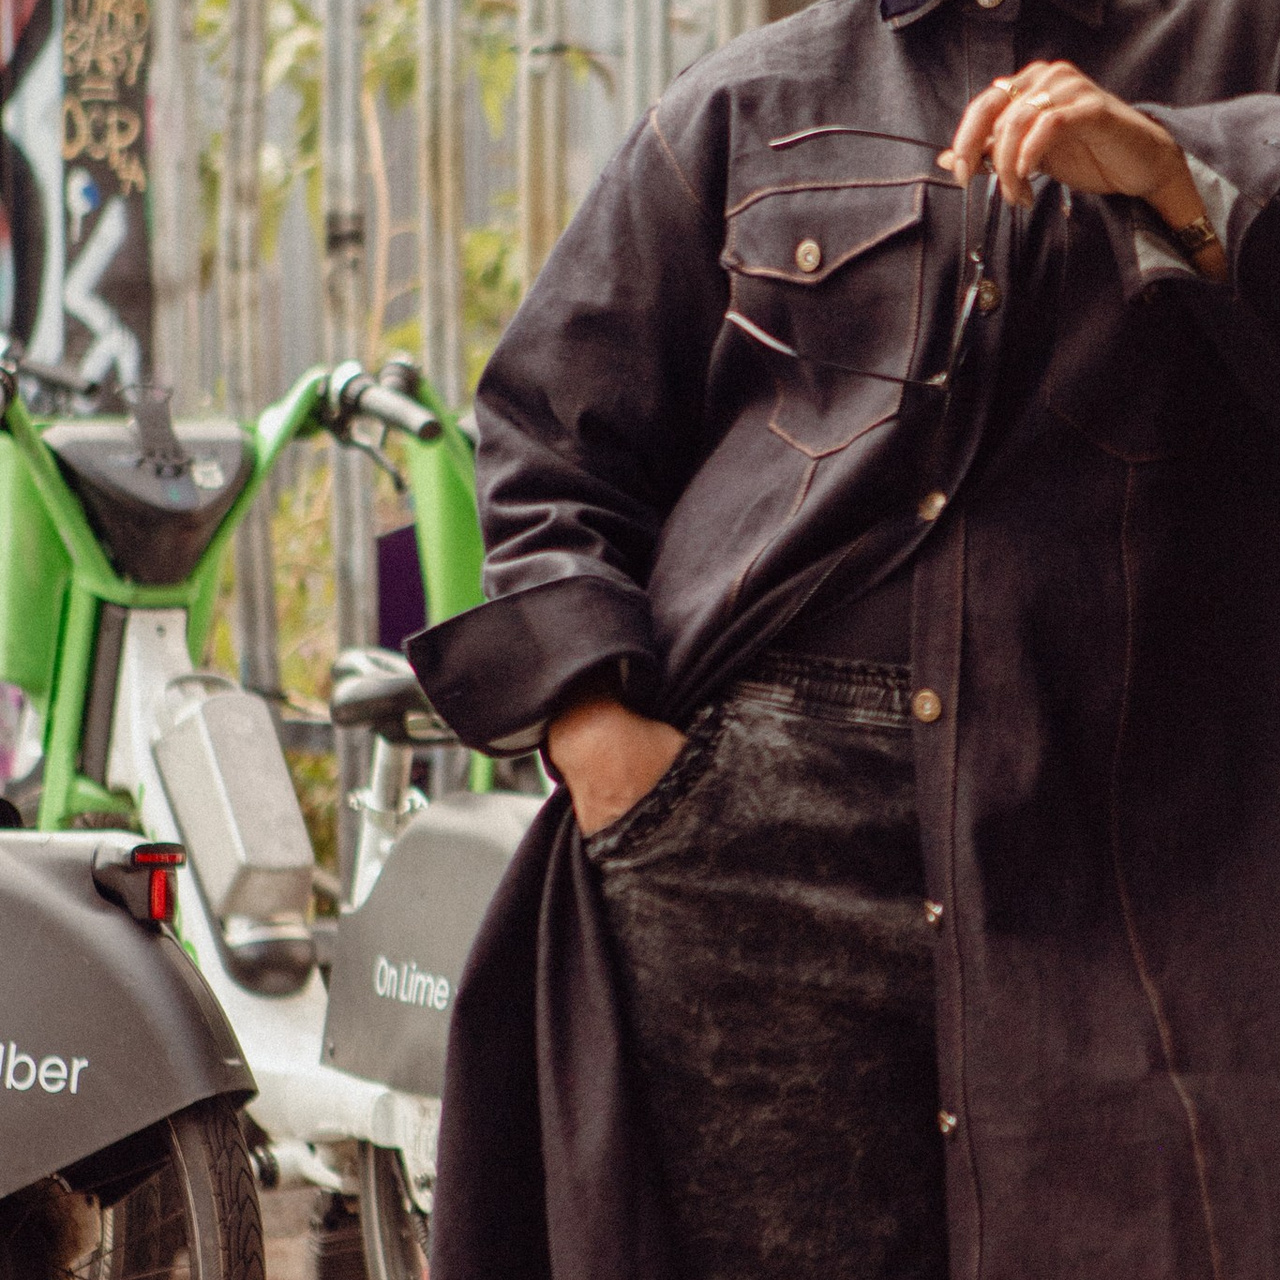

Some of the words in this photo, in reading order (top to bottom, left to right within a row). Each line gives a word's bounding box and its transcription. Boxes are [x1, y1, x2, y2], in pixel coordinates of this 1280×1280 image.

[375, 955, 398, 999] On
[399, 961, 450, 1011] Lime
[0, 1040, 89, 1094] ber
